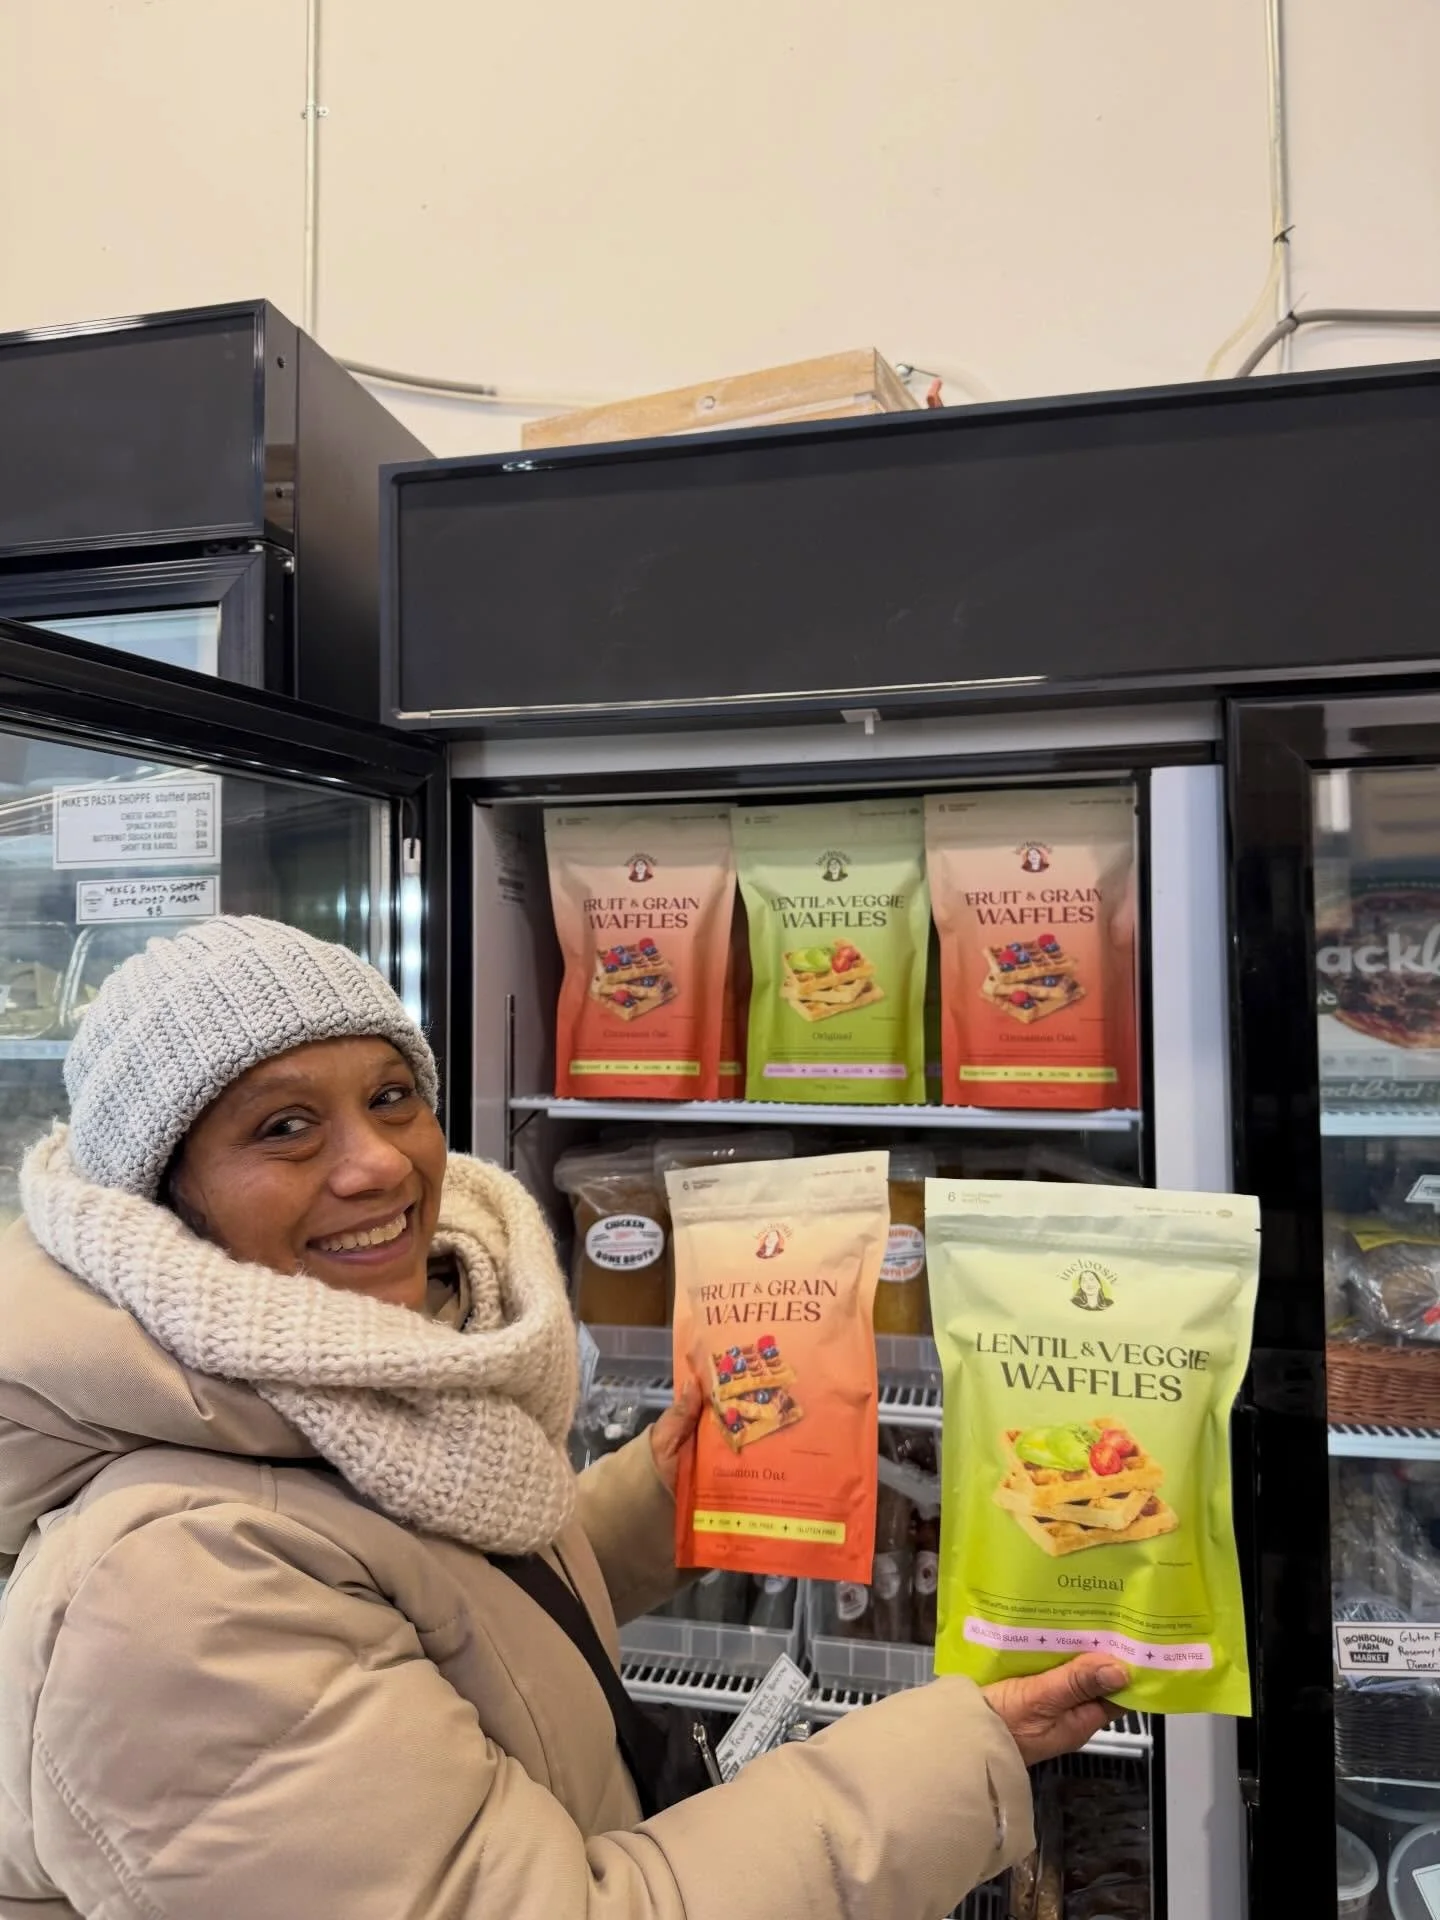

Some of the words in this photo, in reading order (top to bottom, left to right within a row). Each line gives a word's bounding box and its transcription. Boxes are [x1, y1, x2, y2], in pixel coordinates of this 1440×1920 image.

[61, 796, 90, 808] MIKE'S
[91, 795, 117, 807] PASTA
[118, 792, 151, 805] SHOPPE
[187, 791, 211, 804] pasta
[141, 883, 168, 893] PASTA
[170, 880, 208, 893] SHOPPE
[170, 894, 201, 904] PASTA
[583, 897, 627, 912] FRUIT
[630, 900, 641, 909] &
[642, 896, 700, 910] GRAIN
[771, 896, 825, 912] LENTIL
[836, 894, 905, 909] VEGGIE
[965, 890, 1022, 906] FRUIT
[1025, 891, 1036, 902] &
[1040, 887, 1105, 904] GRAIN
[589, 912, 689, 929] WAFFLES
[782, 910, 887, 928] WAFFLES
[976, 905, 1095, 925] WAFFLES
[948, 1191, 957, 1203] 6
[604, 1219, 646, 1231] CHICKEN
[595, 1250, 621, 1264] BONE
[622, 1248, 654, 1264] BROTH
[701, 1281, 752, 1302] FRUIT
[753, 1283, 764, 1294] &
[768, 1279, 838, 1297] GRAIN
[705, 1301, 822, 1326] WAFFLES
[976, 1331, 1078, 1360] LENTIL
[1080, 1340, 1096, 1357] &
[1097, 1341, 1210, 1371] VEGGIE
[1000, 1361, 1183, 1402] WAFFLES
[1057, 1574, 1125, 1592] Original
[1002, 1634, 1029, 1644] SUGAR
[1055, 1636, 1083, 1645] VEGAN
[1343, 1633, 1394, 1647] IRONBOUND
[1400, 1630, 1431, 1643] Gluten
[1163, 1652, 1186, 1662] GLUTEN
[1187, 1652, 1204, 1661] FREE
[1353, 1652, 1387, 1662] MARKET
